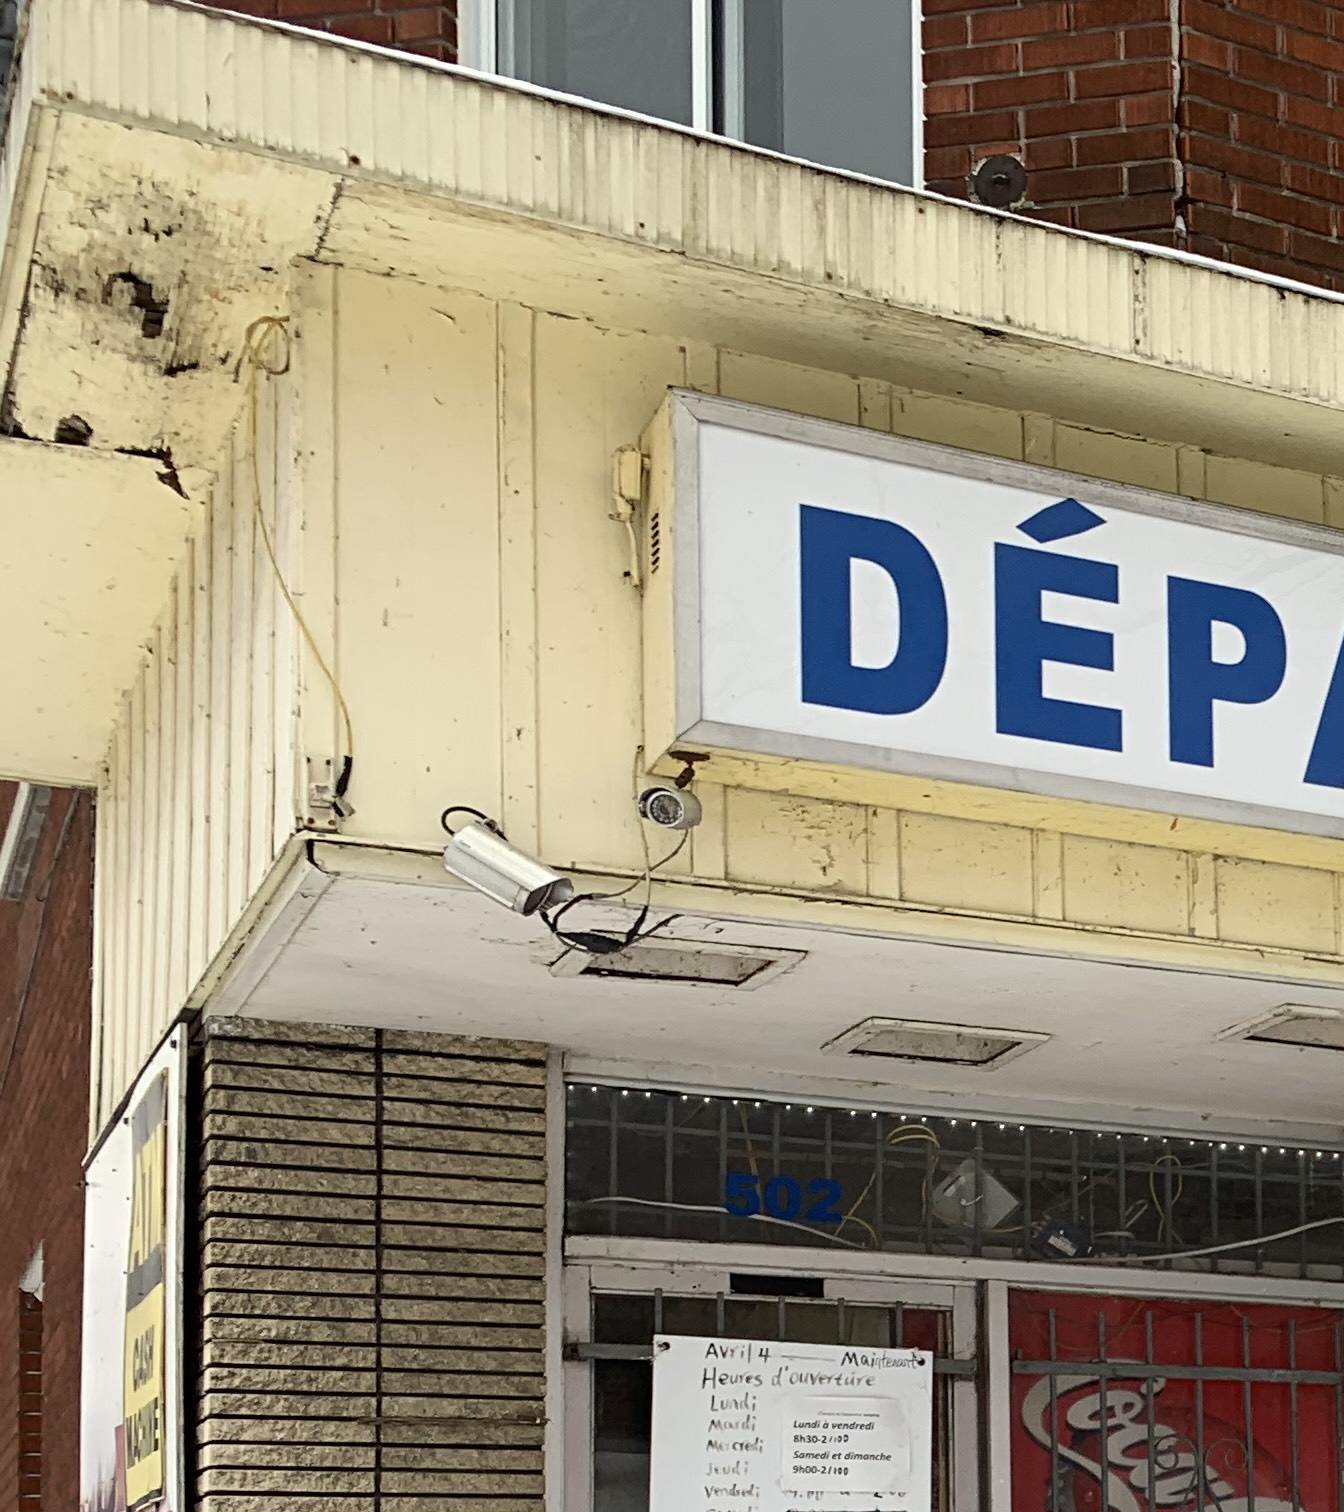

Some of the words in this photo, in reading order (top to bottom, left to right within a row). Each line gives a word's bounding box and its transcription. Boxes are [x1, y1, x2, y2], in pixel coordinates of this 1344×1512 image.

[725, 1173, 843, 1223] 502
[705, 1343, 752, 1363] Avril
[758, 1347, 770, 1363] 4
[702, 1367, 763, 1390] Heures
[770, 1365, 876, 1387] d'ouverture
[711, 1392, 757, 1412] Lundi
[708, 1414, 757, 1433] Mardi
[793, 1419, 821, 1430] Lundi
[832, 1420, 875, 1431] vendredi
[706, 1437, 764, 1454] Mercredi
[793, 1450, 830, 1461] Samedi
[832, 1452, 842, 1461] et
[844, 1452, 892, 1462] dimanche
[706, 1460, 749, 1477] Jeudi
